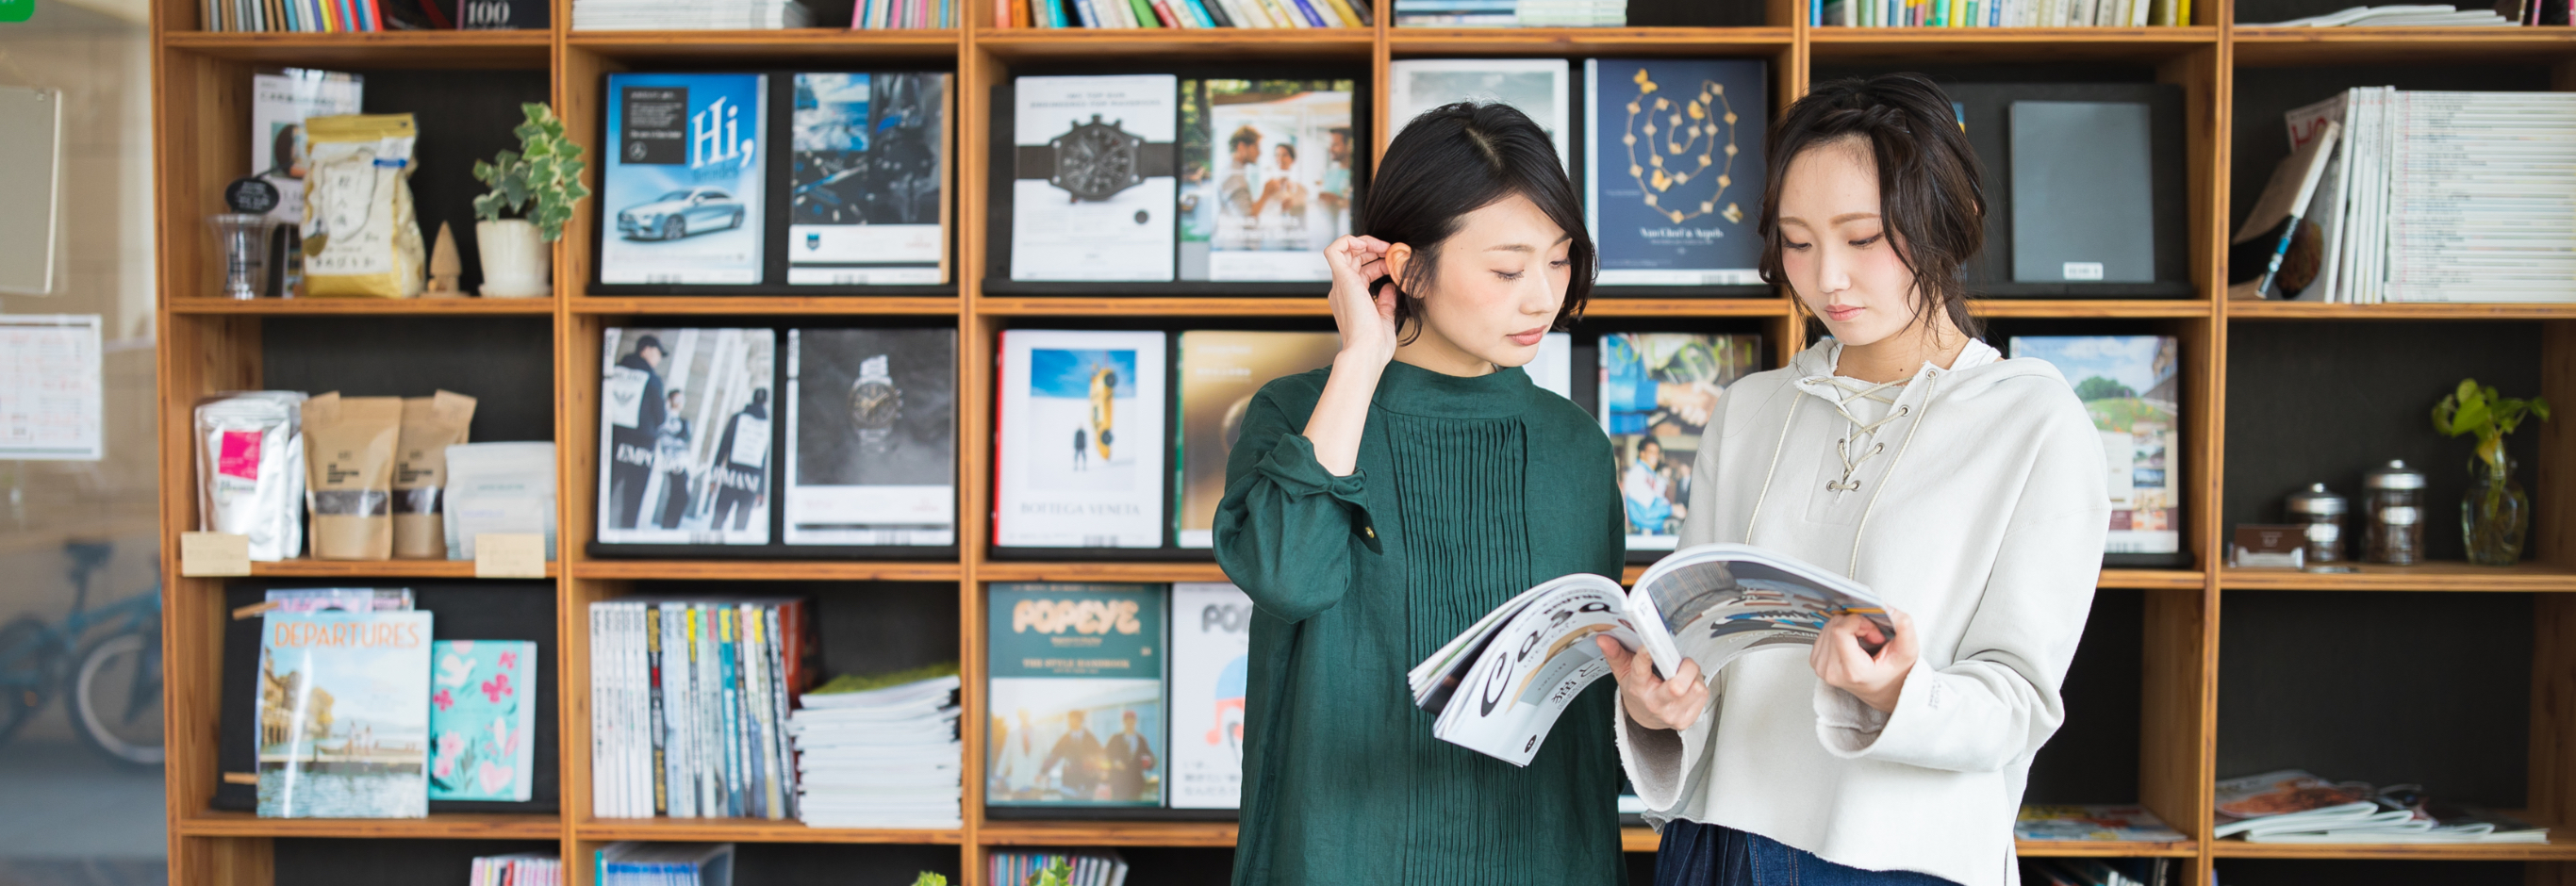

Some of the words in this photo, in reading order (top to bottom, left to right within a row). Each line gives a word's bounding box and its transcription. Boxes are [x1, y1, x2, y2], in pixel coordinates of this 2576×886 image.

[468, 1, 510, 25] 100
[691, 95, 753, 170] Hi,
[1013, 599, 1141, 634] POPEYE
[273, 621, 421, 648] DEPARTURES
[1480, 601, 1620, 718] Casa
